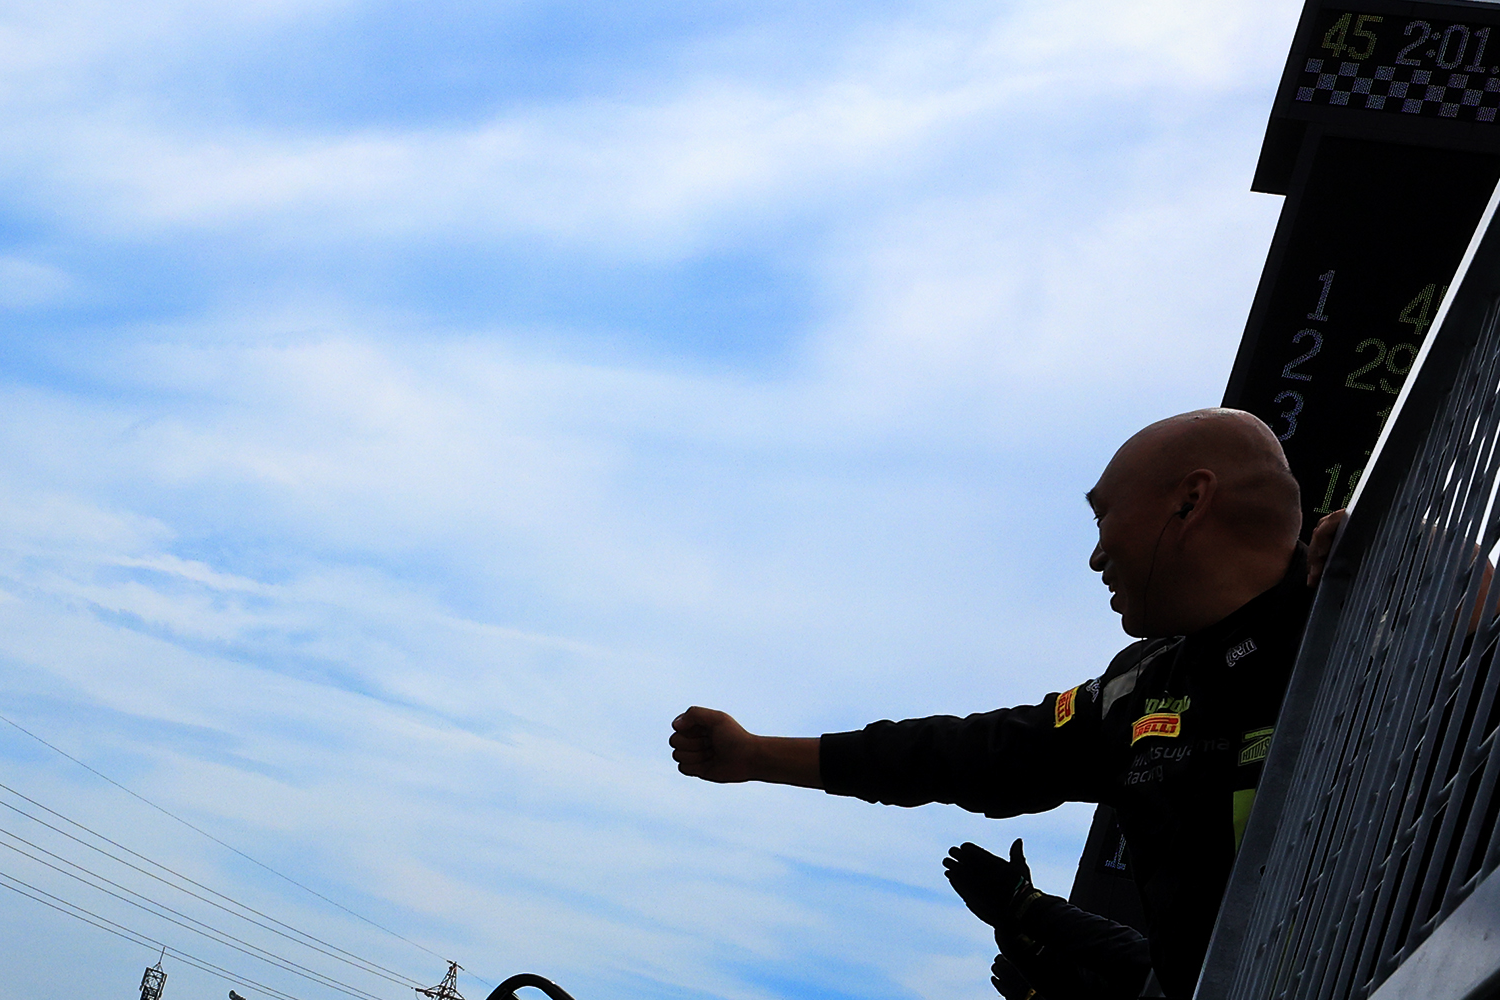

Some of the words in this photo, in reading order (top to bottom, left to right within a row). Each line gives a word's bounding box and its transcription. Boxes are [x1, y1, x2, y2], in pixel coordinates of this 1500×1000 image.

[1321, 13, 1383, 60] 45
[1306, 269, 1336, 322] 1
[1281, 328, 1324, 382] 2
[1270, 390, 1304, 442] 3
